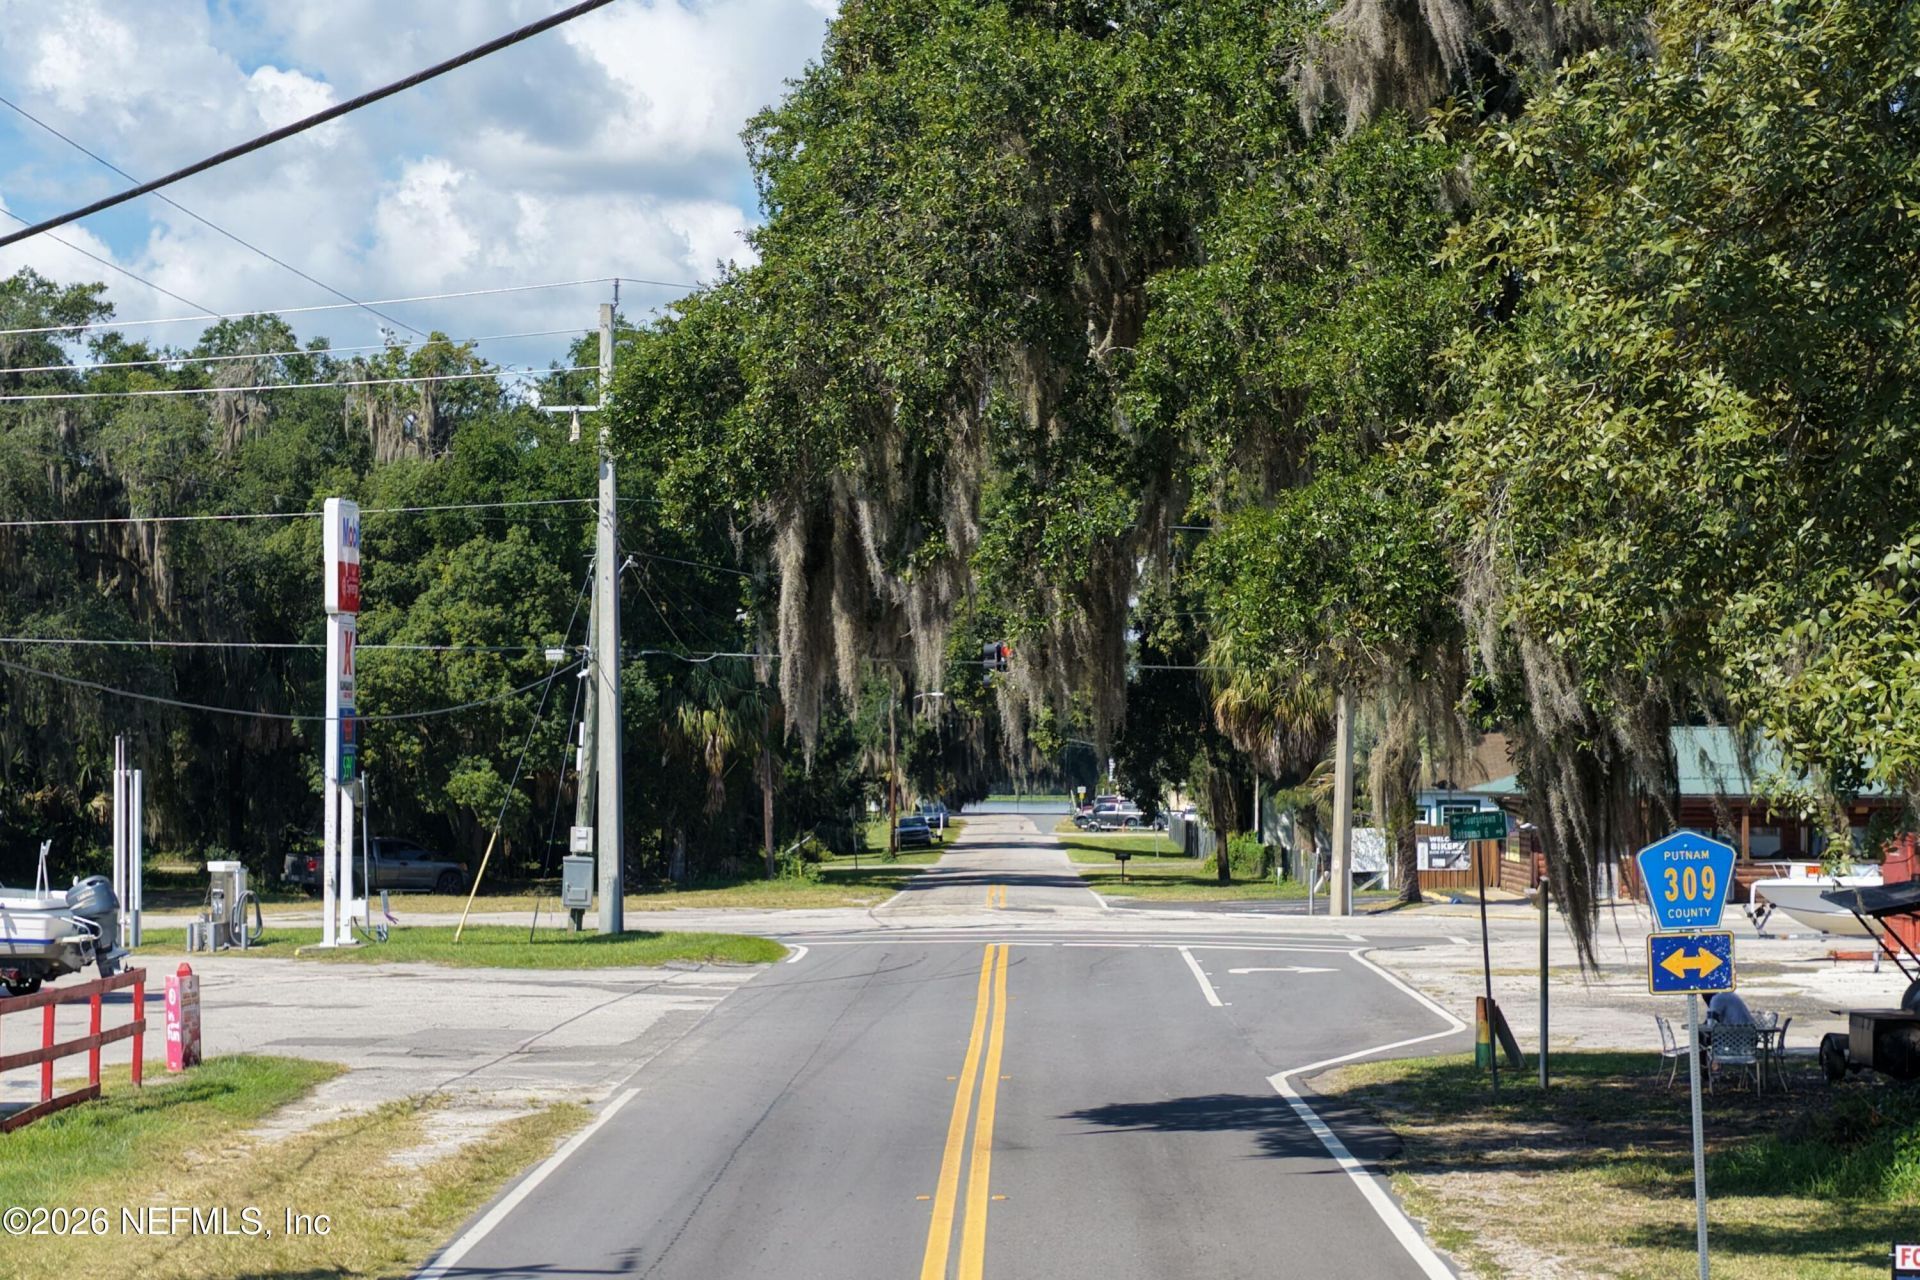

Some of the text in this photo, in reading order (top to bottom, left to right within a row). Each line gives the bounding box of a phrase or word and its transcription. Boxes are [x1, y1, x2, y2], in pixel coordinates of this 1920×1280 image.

[1485, 827, 1489, 838] 6
[1664, 850, 1709, 860] PUTNAM
[1664, 866, 1715, 901] 309
[1668, 908, 1711, 918] COUNTY
